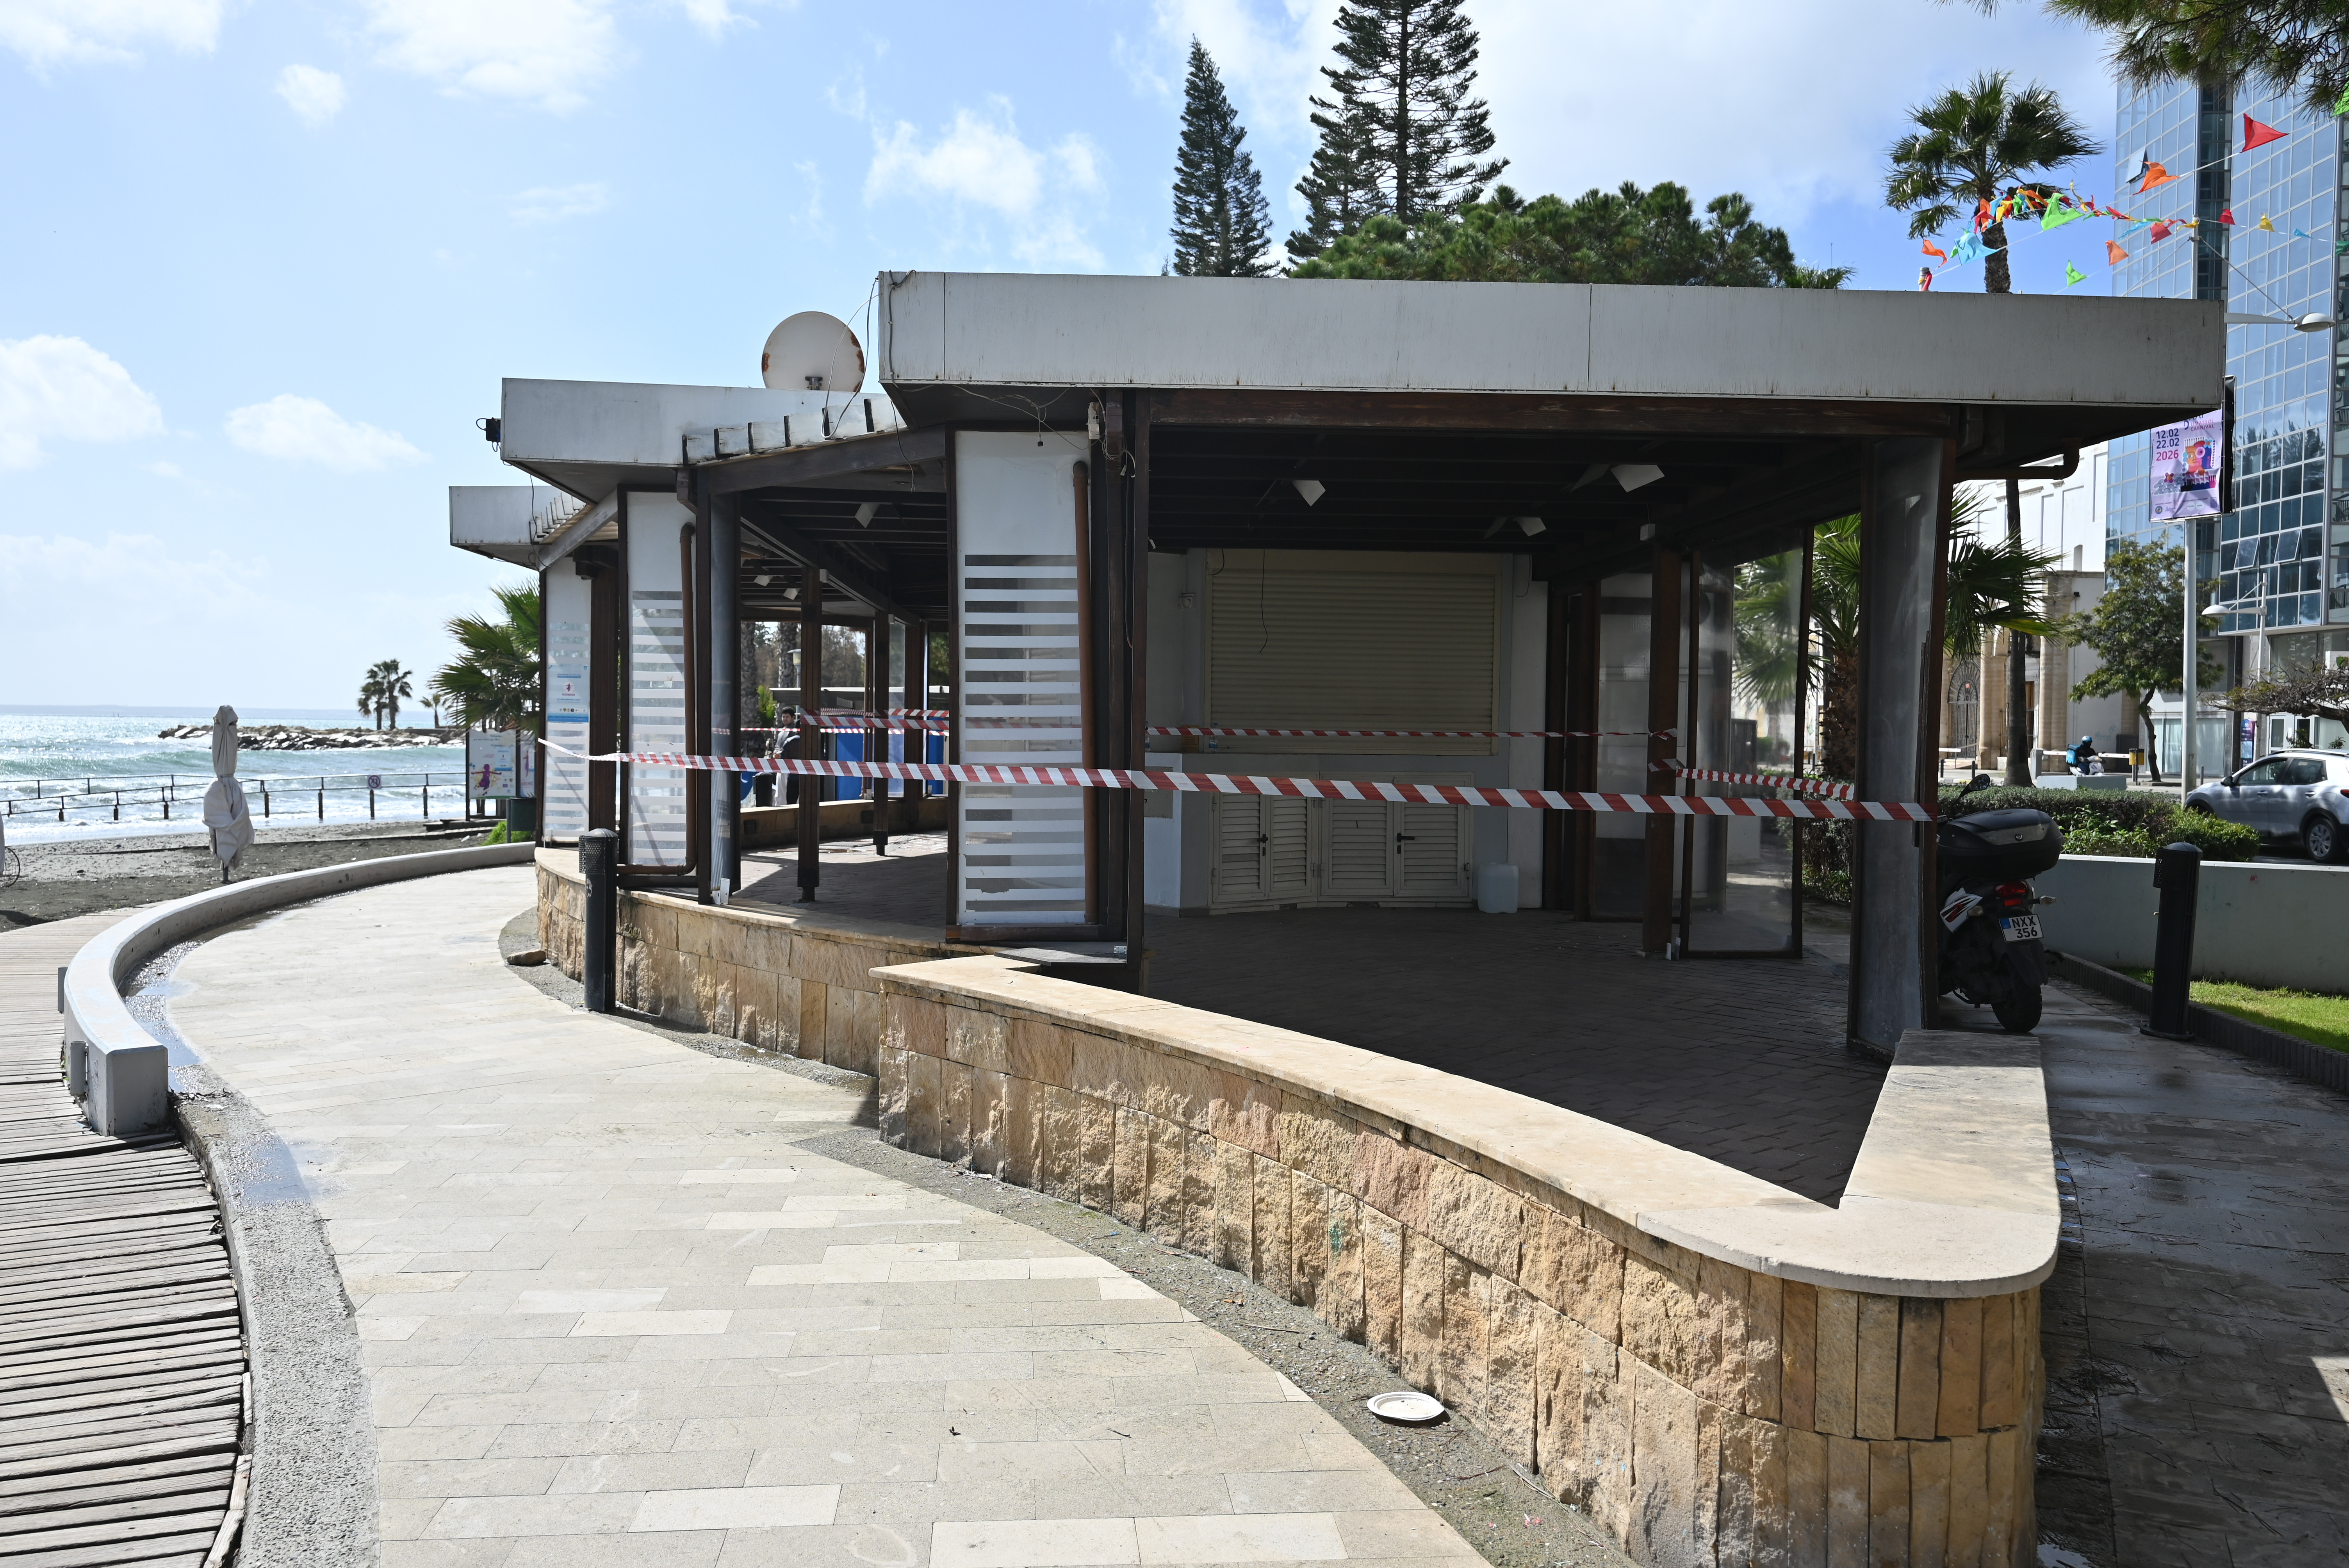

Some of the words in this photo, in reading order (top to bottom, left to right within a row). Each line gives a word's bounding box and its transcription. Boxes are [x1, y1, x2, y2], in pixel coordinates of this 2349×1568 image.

[2156, 428, 2179, 439] 12.02
[2156, 438, 2180, 449] 22.02
[2156, 449, 2179, 461] 2026
[2011, 916, 2036, 928] NXX
[2015, 927, 2037, 938] 356
